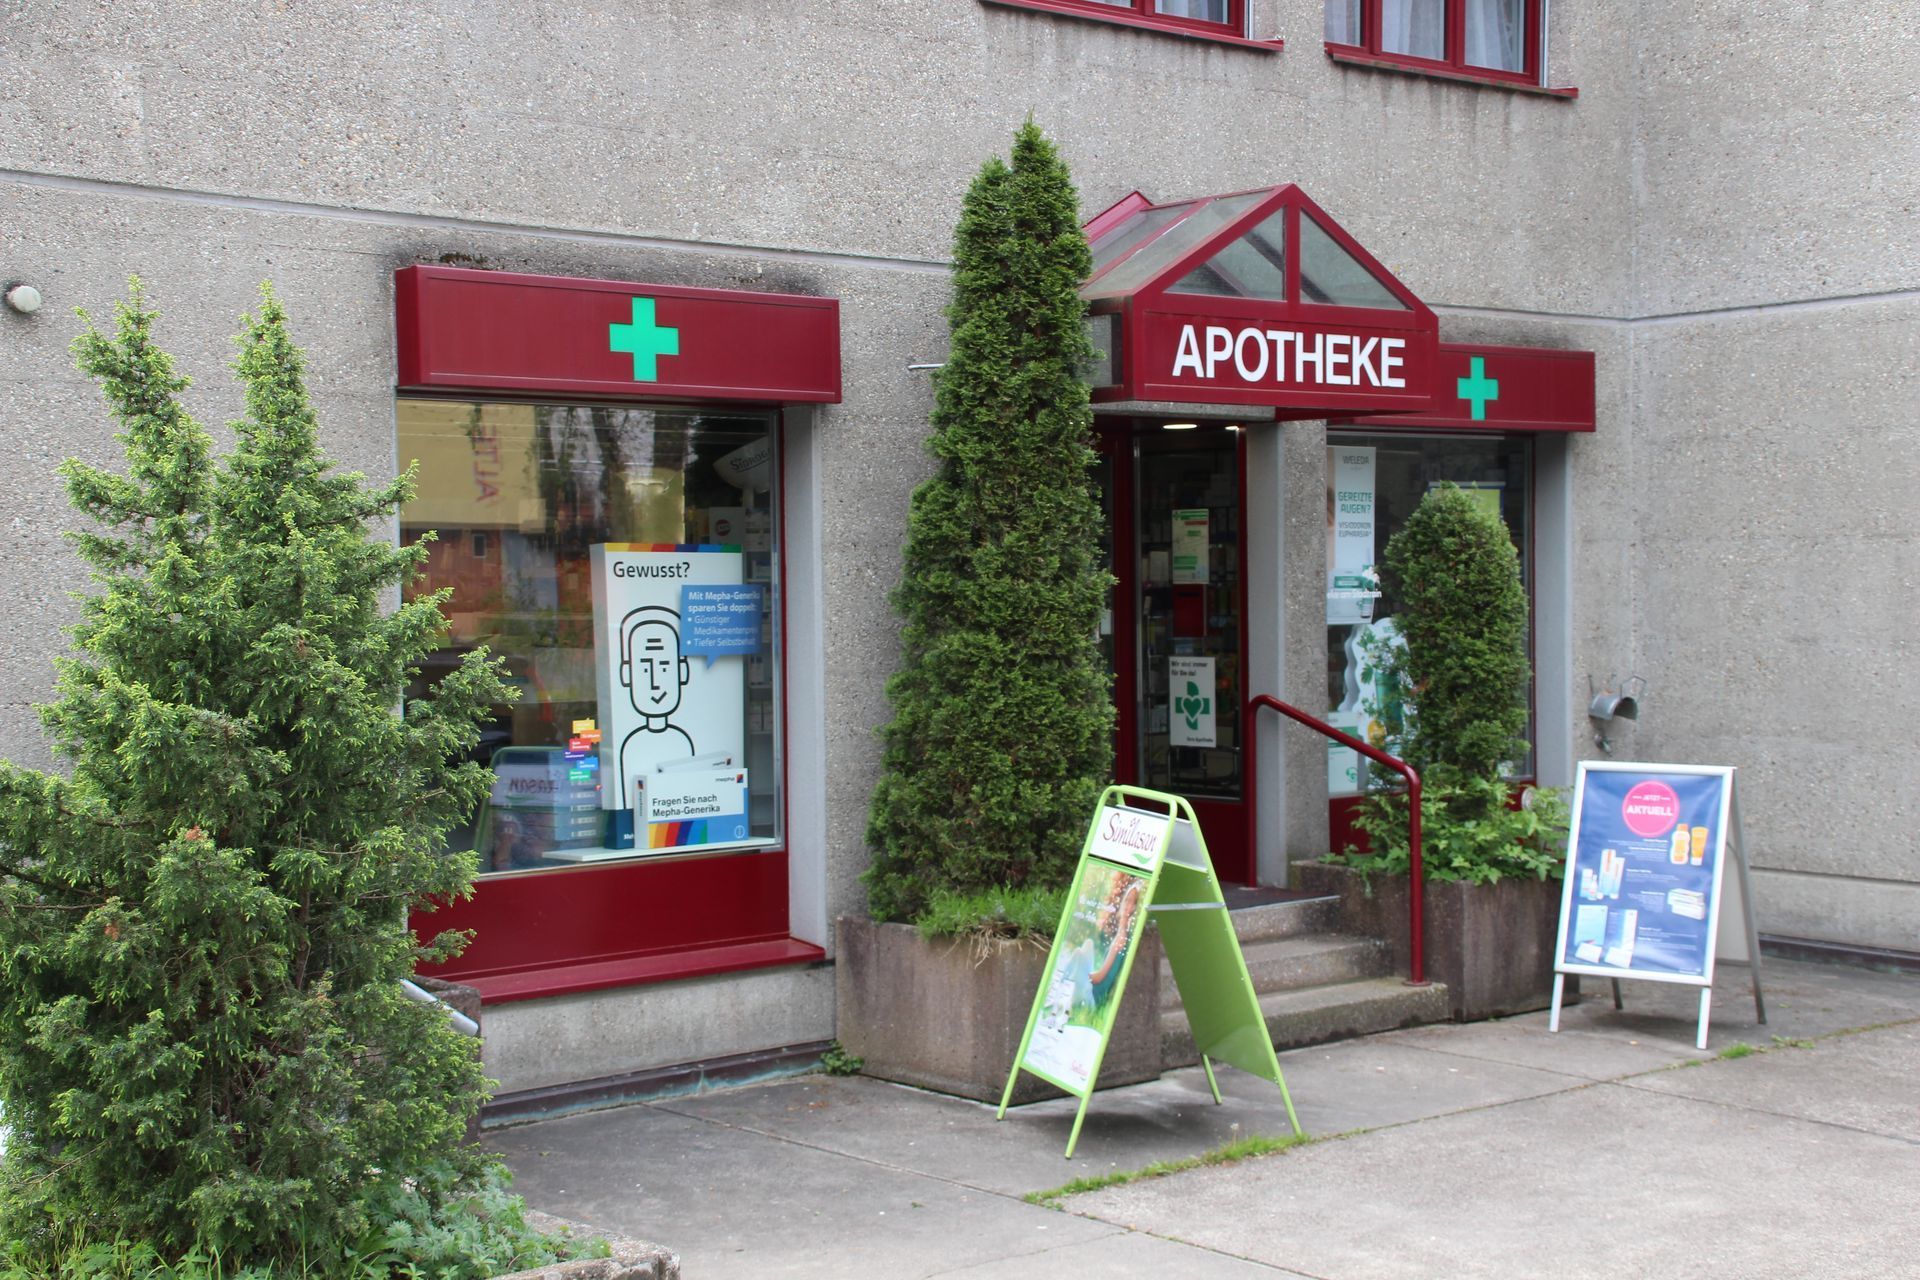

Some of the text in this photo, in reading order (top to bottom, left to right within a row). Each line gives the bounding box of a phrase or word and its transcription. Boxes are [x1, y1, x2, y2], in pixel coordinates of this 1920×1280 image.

[1171, 324, 1406, 388] APOTHEKE
[1342, 455, 1370, 465] WELEDA
[1338, 491, 1373, 502] GEREIZTE
[1340, 503, 1371, 514] AUGEN?
[613, 561, 690, 578] Gewusst?
[688, 591, 703, 601] Mit
[687, 604, 716, 614] sparen
[717, 603, 728, 612] Sie
[652, 794, 718, 807] Fragen Sie nach
[652, 804, 721, 817] Mepha-Generika
[1627, 804, 1673, 817] AKTUELL
[1103, 812, 1157, 852] Similasan
